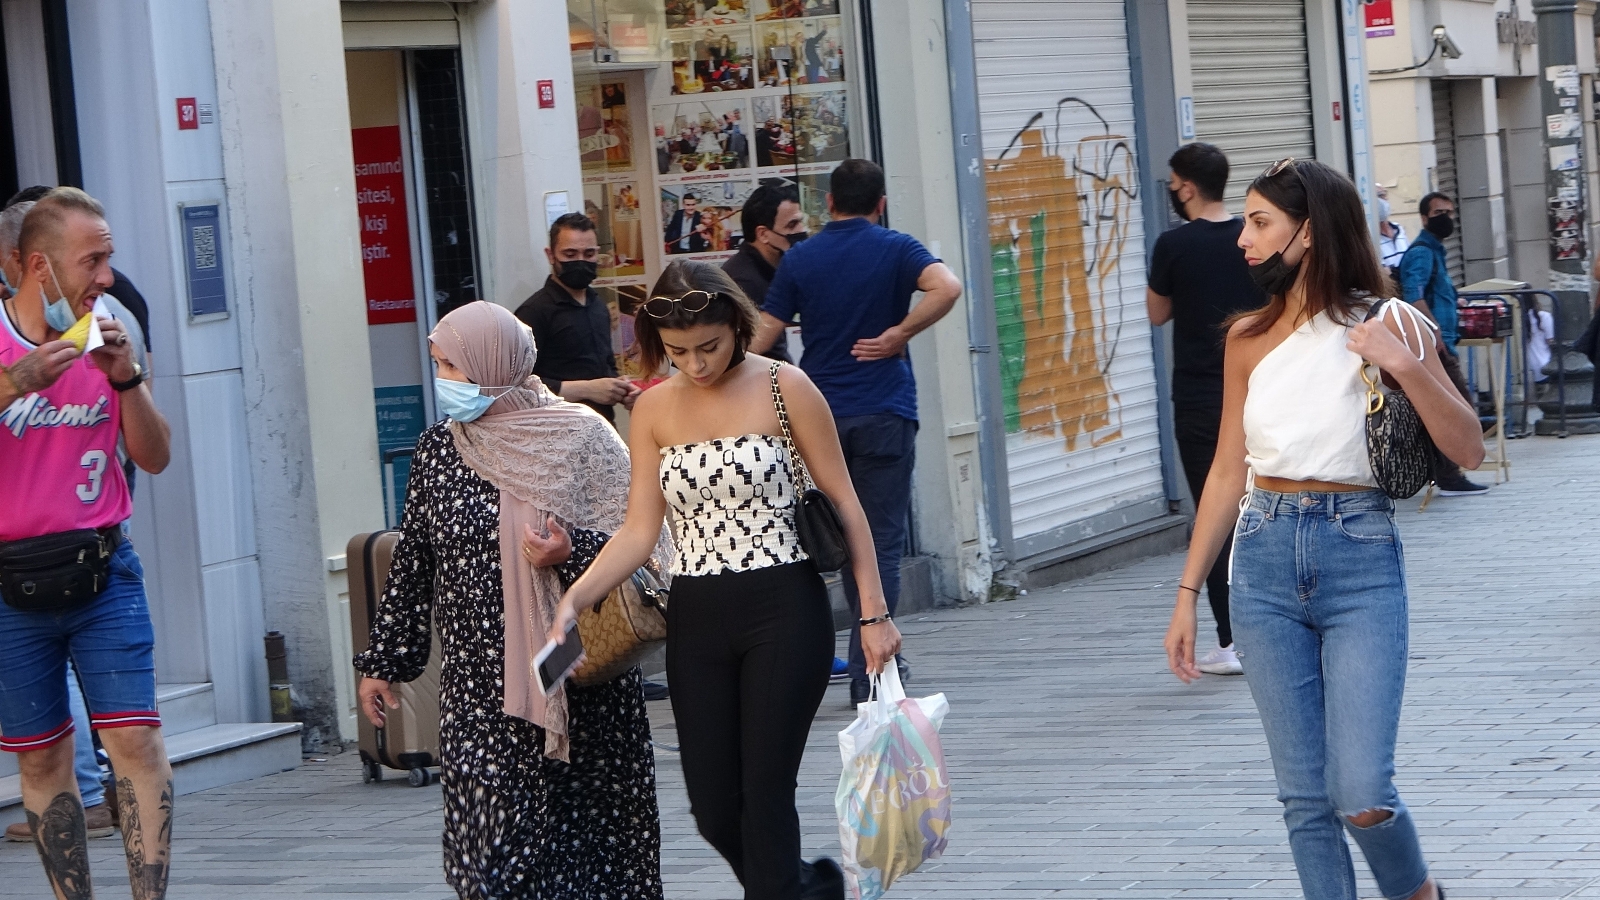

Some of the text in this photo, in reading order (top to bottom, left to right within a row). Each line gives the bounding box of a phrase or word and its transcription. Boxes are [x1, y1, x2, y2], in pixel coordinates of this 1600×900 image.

[181, 105, 194, 122] 37
[357, 186, 395, 205] sitesi,
[365, 214, 388, 235] kişi
[0, 392, 110, 439] Miami
[76, 449, 107, 504] 3
